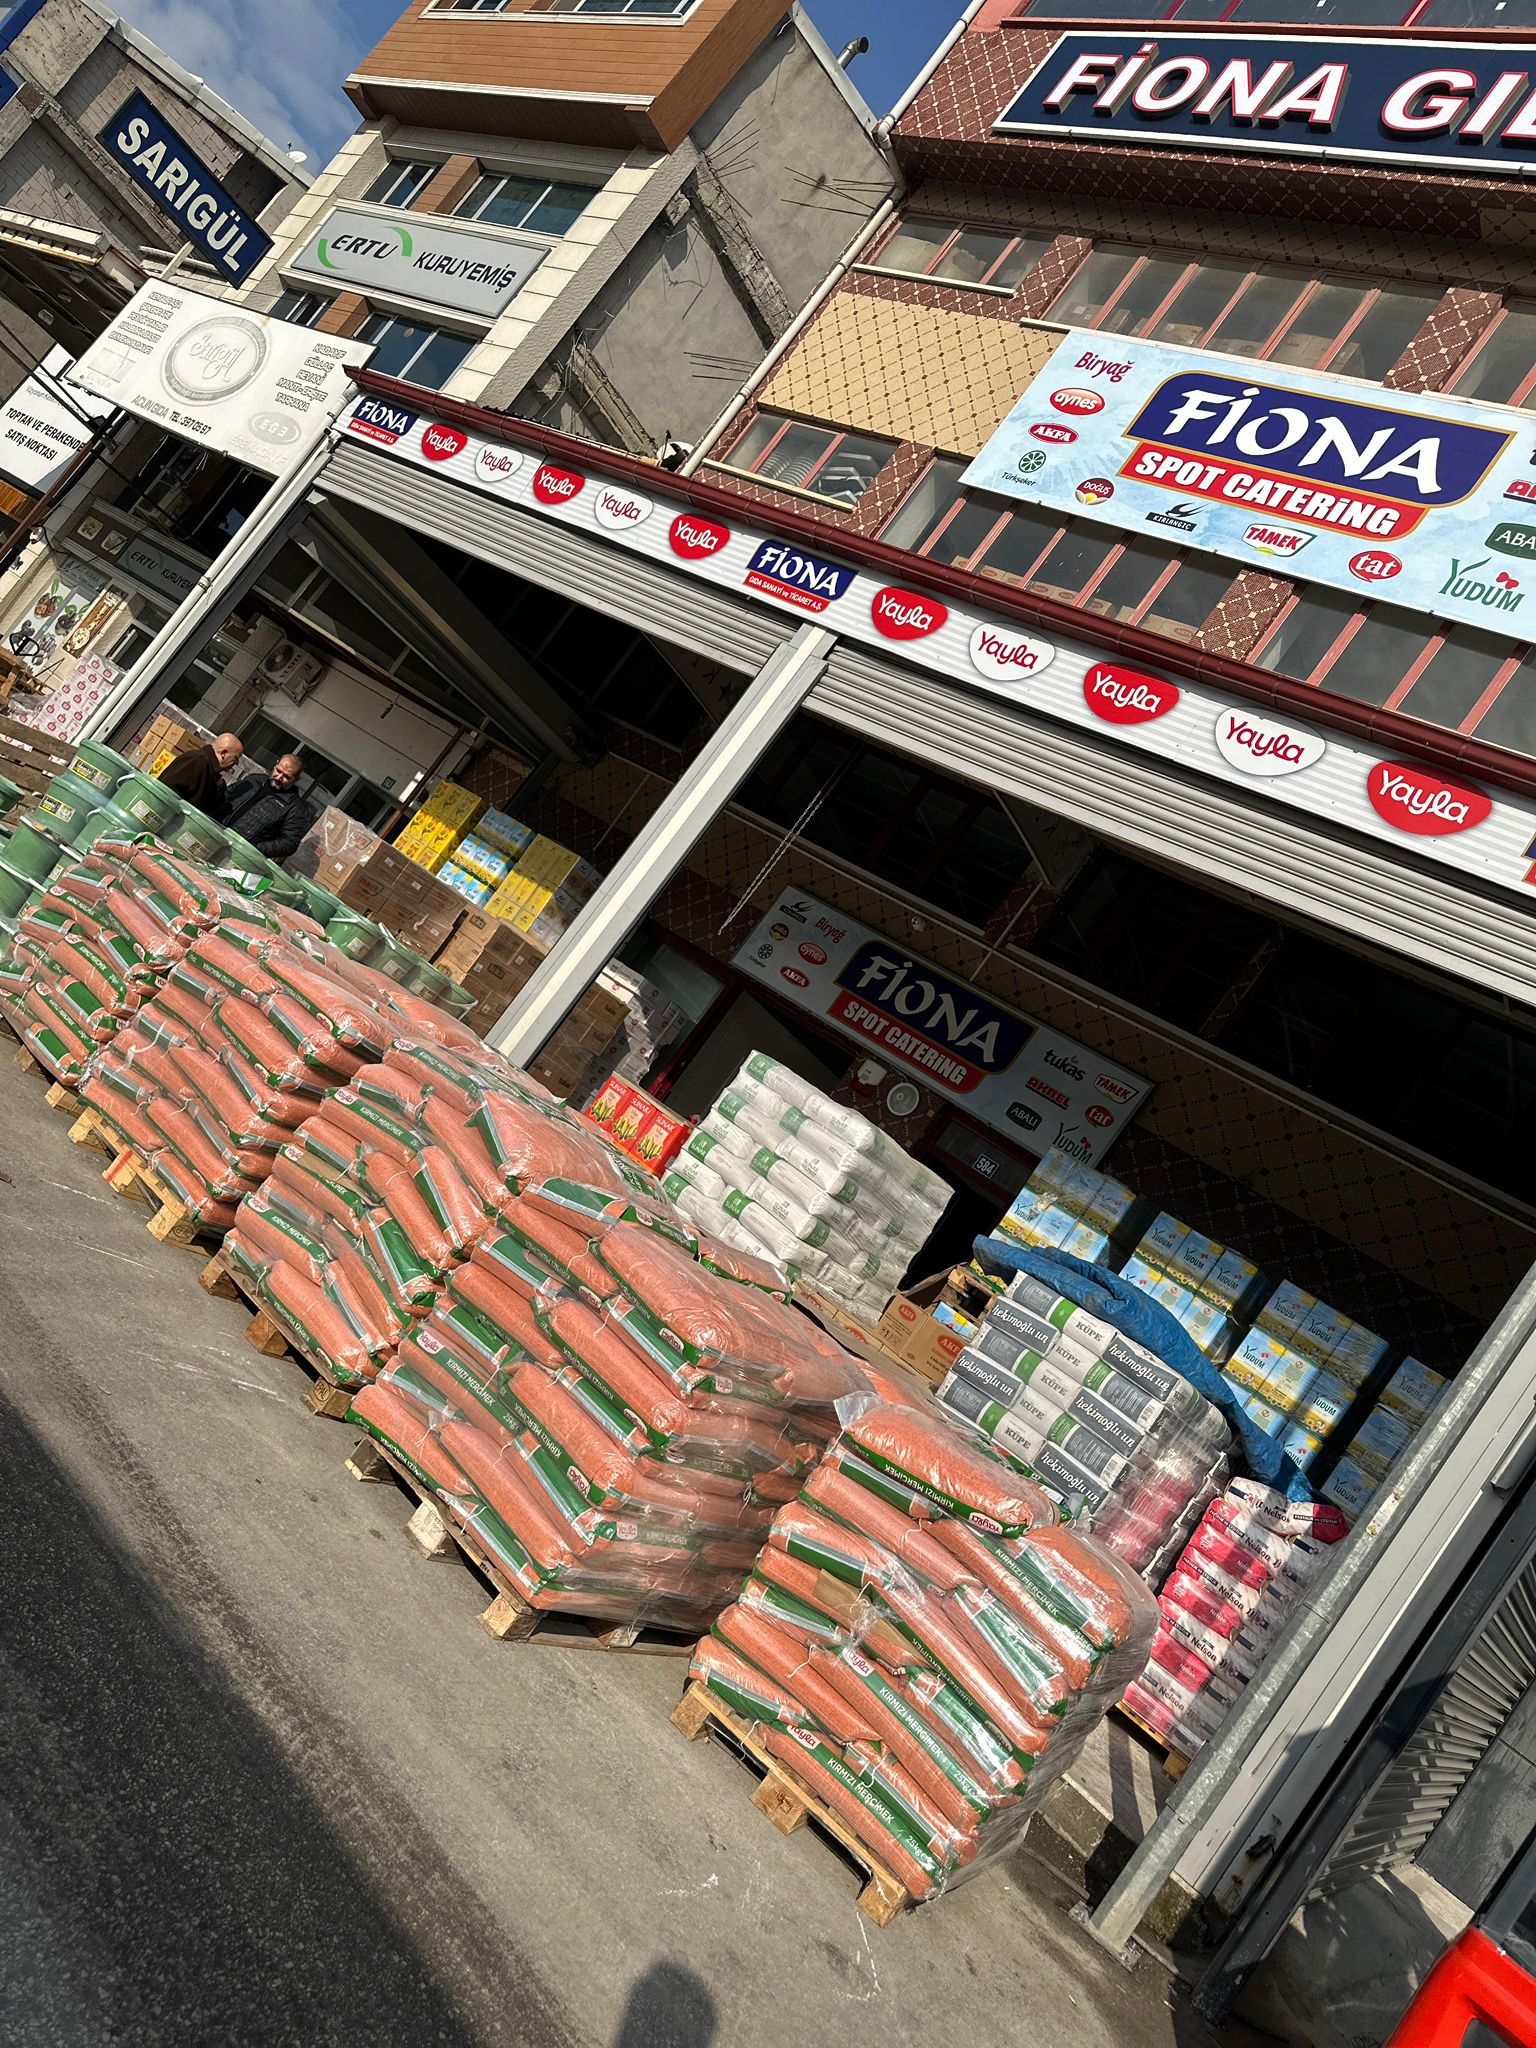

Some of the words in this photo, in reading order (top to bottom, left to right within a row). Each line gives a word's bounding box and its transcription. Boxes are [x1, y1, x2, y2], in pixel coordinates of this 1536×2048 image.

[1042, 42, 1349, 128] FİONA
[117, 117, 248, 272] SARIGÜL
[331, 234, 399, 260] ERTU
[412, 251, 517, 293] KURUYEMİŞ
[1074, 352, 1136, 383] Biryağ
[1054, 392, 1099, 411] aynes
[5, 407, 32, 430] TOPTAN
[31, 418, 44, 432] VE
[358, 401, 409, 434] FİONA
[5, 428, 25, 447] SATIŞ
[25, 438, 58, 461] NOKTASI
[426, 429, 458, 454] Yayla
[1033, 425, 1072, 443] AKFA
[1163, 386, 1442, 495] FİONA
[480, 449, 513, 473] Yayla
[1134, 450, 1228, 498] SPOT
[538, 469, 575, 497] Yayla
[1001, 471, 1037, 487] Türkşeker
[1083, 481, 1111, 495] DOĞUŞ
[600, 491, 642, 521] Yayla
[673, 520, 719, 551] Yayla
[1152, 514, 1192, 531] KIRLANGIÇ
[1245, 526, 1303, 551] TAMEK
[130, 551, 158, 571] ERTU
[757, 546, 840, 597] FİONA
[1355, 552, 1396, 578] tat
[1438, 556, 1527, 613] YUDUM
[878, 594, 933, 632] Yayla
[977, 631, 1040, 671] Yayla
[1091, 671, 1162, 715] Yayla
[1224, 716, 1305, 765] Yayla
[1376, 770, 1471, 825] Yayla
[815, 917, 848, 944] Biryağ
[800, 944, 824, 963] aynes
[784, 968, 807, 986] AKFA
[843, 1000, 890, 1038] SPOT
[856, 954, 1001, 1064] FİONA
[1043, 1049, 1086, 1082] tukaş
[338, 1088, 354, 1103] Yayla
[610, 1080, 628, 1095] SUNAR
[1096, 1076, 1132, 1101] TAMEK
[631, 1097, 650, 1114] SUNAR
[1011, 1106, 1038, 1128] ABALI
[1088, 1107, 1111, 1126] tat
[377, 1117, 404, 1137] MERCİMEK
[656, 1115, 675, 1132] SUNAR
[691, 1142, 707, 1157] SUNAR
[1051, 1121, 1093, 1165] YUDUM
[977, 1156, 996, 1176] 584
[663, 1184, 678, 1198] SUNAR
[725, 1201, 741, 1215] SUNAR
[1152, 1227, 1172, 1249] YUDUM
[1183, 1246, 1205, 1270] YUDUM
[1217, 1267, 1239, 1291] YUDUM
[1273, 1296, 1296, 1321] YUDUM
[991, 1304, 1036, 1336] hekimoğlu
[1034, 1330, 1049, 1344] un
[1075, 1320, 1103, 1342] KÜPE
[1308, 1318, 1332, 1344] YUDUM
[420, 1332, 440, 1352] Yayla
[1055, 1345, 1081, 1367] KÜPE
[1108, 1343, 1156, 1381] hekimoğlu
[1153, 1376, 1170, 1392] un
[1243, 1344, 1266, 1370] YUDUM
[446, 1358, 468, 1381] KIRMIZI
[465, 1377, 496, 1406] MERCİMEK
[958, 1355, 1001, 1388] hekimoğlu
[1000, 1382, 1014, 1396] un
[1041, 1374, 1068, 1397] KÜPE
[1400, 1374, 1424, 1401] YUDUM
[314, 1379, 328, 1400] EPAL
[1020, 1398, 1046, 1420] KÜPE
[1313, 1391, 1337, 1416] YUDUM
[514, 1403, 544, 1434] MERCİMEK
[539, 1430, 562, 1459] KIRMIZI
[1075, 1396, 1123, 1435] hekimoğlu
[1120, 1432, 1136, 1448] un
[1004, 1427, 1031, 1450] KÜPE
[569, 1468, 588, 1493] Yayla
[884, 1464, 925, 1492] MERCİMEK
[928, 1488, 955, 1509] KIRMIZI
[1040, 1451, 1086, 1491] hekimoğlu
[1084, 1488, 1100, 1504] un
[1333, 1476, 1357, 1503] YUDUM
[971, 1513, 1002, 1534] Yayla
[1245, 1537, 1272, 1561] Nelson
[995, 1548, 1024, 1577] KIRMIZI
[1021, 1574, 1059, 1616] MERCİMEK
[1218, 1585, 1244, 1610] Nelson
[1190, 1636, 1217, 1662] Nelson
[1158, 1685, 1185, 1711] Nelson
[879, 1687, 909, 1717] KIRMIZI
[905, 1713, 943, 1758] MERCİMEK
[827, 1757, 856, 1787] KIRMIZI
[854, 1781, 895, 1826] MERCİMEK
